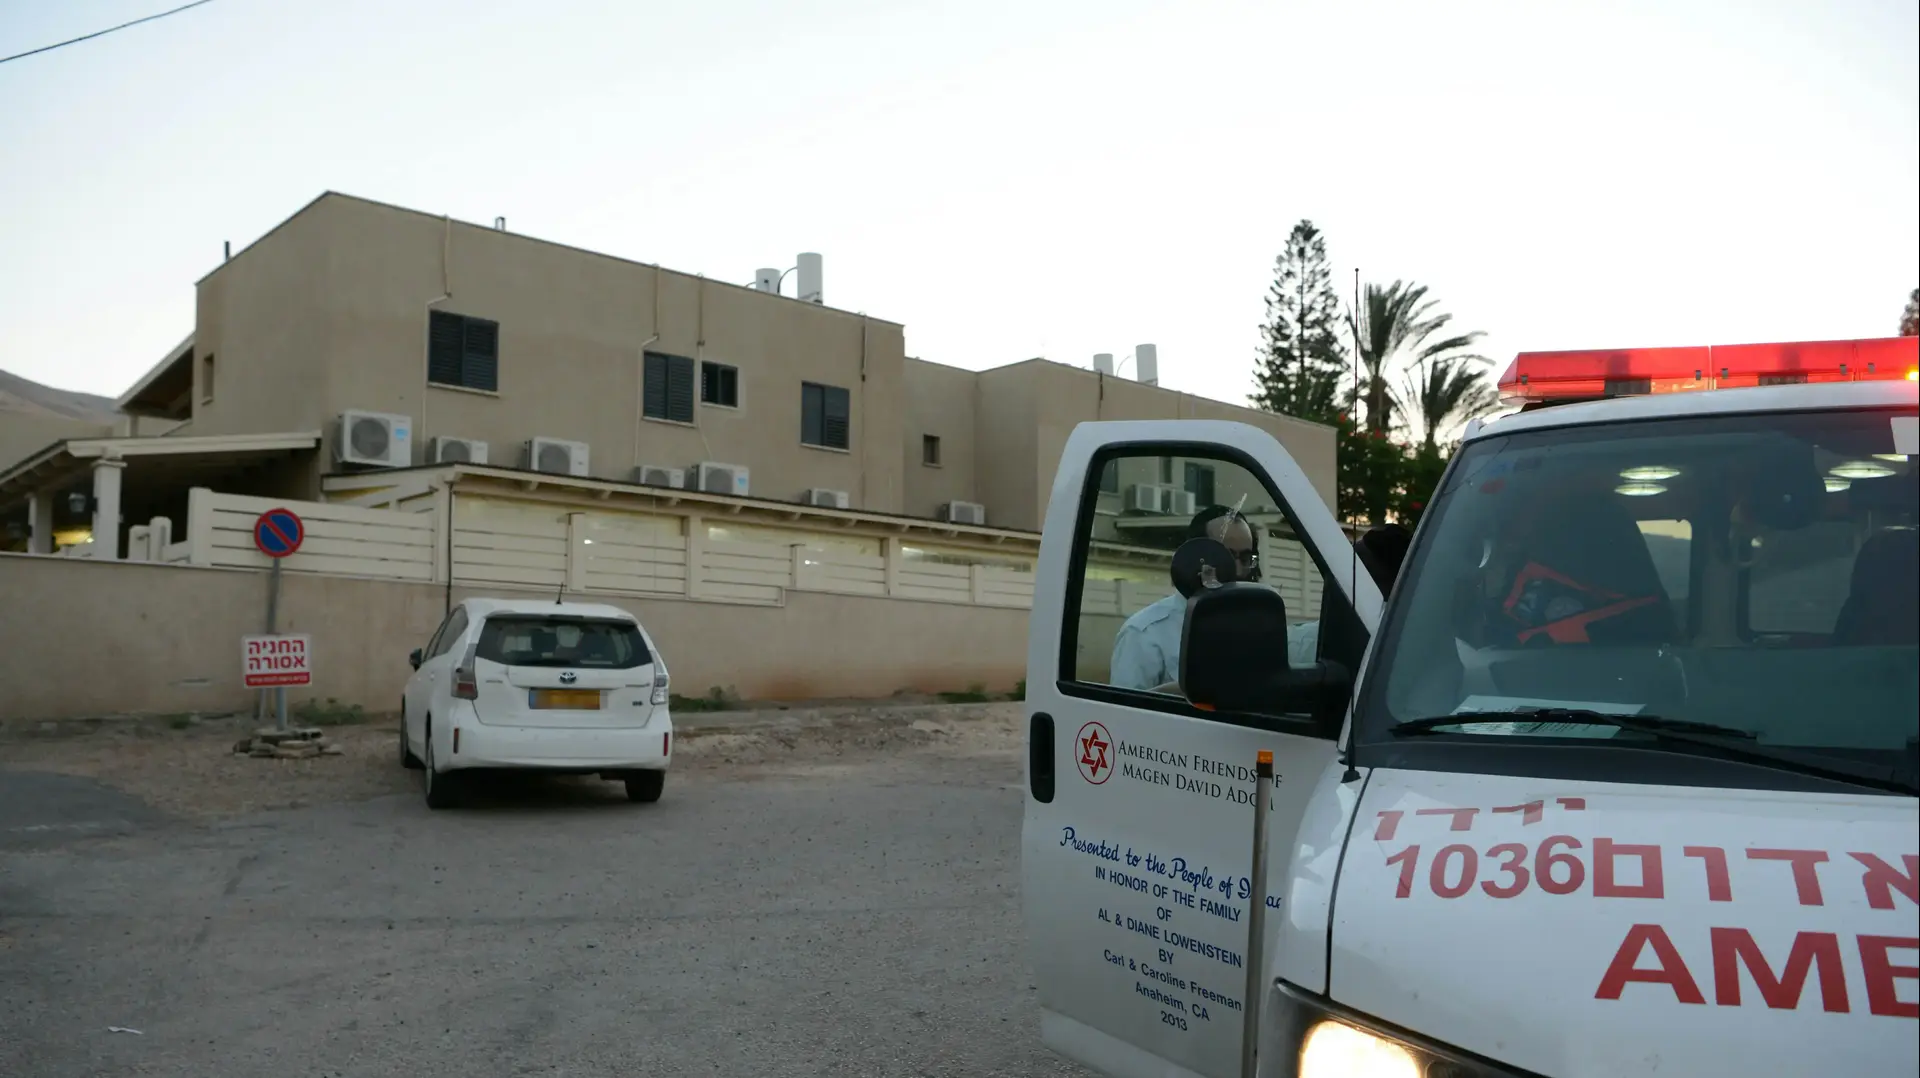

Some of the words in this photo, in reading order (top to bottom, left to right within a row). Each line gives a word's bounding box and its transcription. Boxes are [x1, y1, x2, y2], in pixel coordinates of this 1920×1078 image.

[248, 639, 305, 655] החניה
[248, 655, 306, 670] אסורה
[1118, 740, 1188, 768] AMERICAN
[1122, 762, 1170, 785] MAGEN
[1175, 773, 1222, 799] DAVID
[1226, 785, 1275, 811] ADO
[1060, 826, 1120, 863] Presented
[1125, 848, 1142, 867] to
[1145, 853, 1167, 876] the
[1168, 857, 1214, 893] People
[1218, 877, 1234, 900] of
[1386, 834, 1586, 899] 1036
[1095, 865, 1106, 880] IN
[1109, 870, 1149, 895] HONOR
[1152, 883, 1169, 899] OF
[1172, 889, 1195, 909] THE
[1199, 897, 1242, 922] FAMILY
[1156, 906, 1173, 922] OF
[1098, 907, 1112, 923] AL
[1115, 913, 1123, 927] &
[1127, 917, 1160, 940] DIANE
[1163, 929, 1242, 968] LOWENSTEIN
[1158, 948, 1175, 965] BY
[1129, 958, 1137, 972] &
[1141, 962, 1187, 990] Caroline
[1190, 981, 1242, 1012] Freeman
[1135, 981, 1188, 1016] Anaheim,
[1191, 1002, 1211, 1022] CA
[1160, 1009, 1188, 1032] 2013
